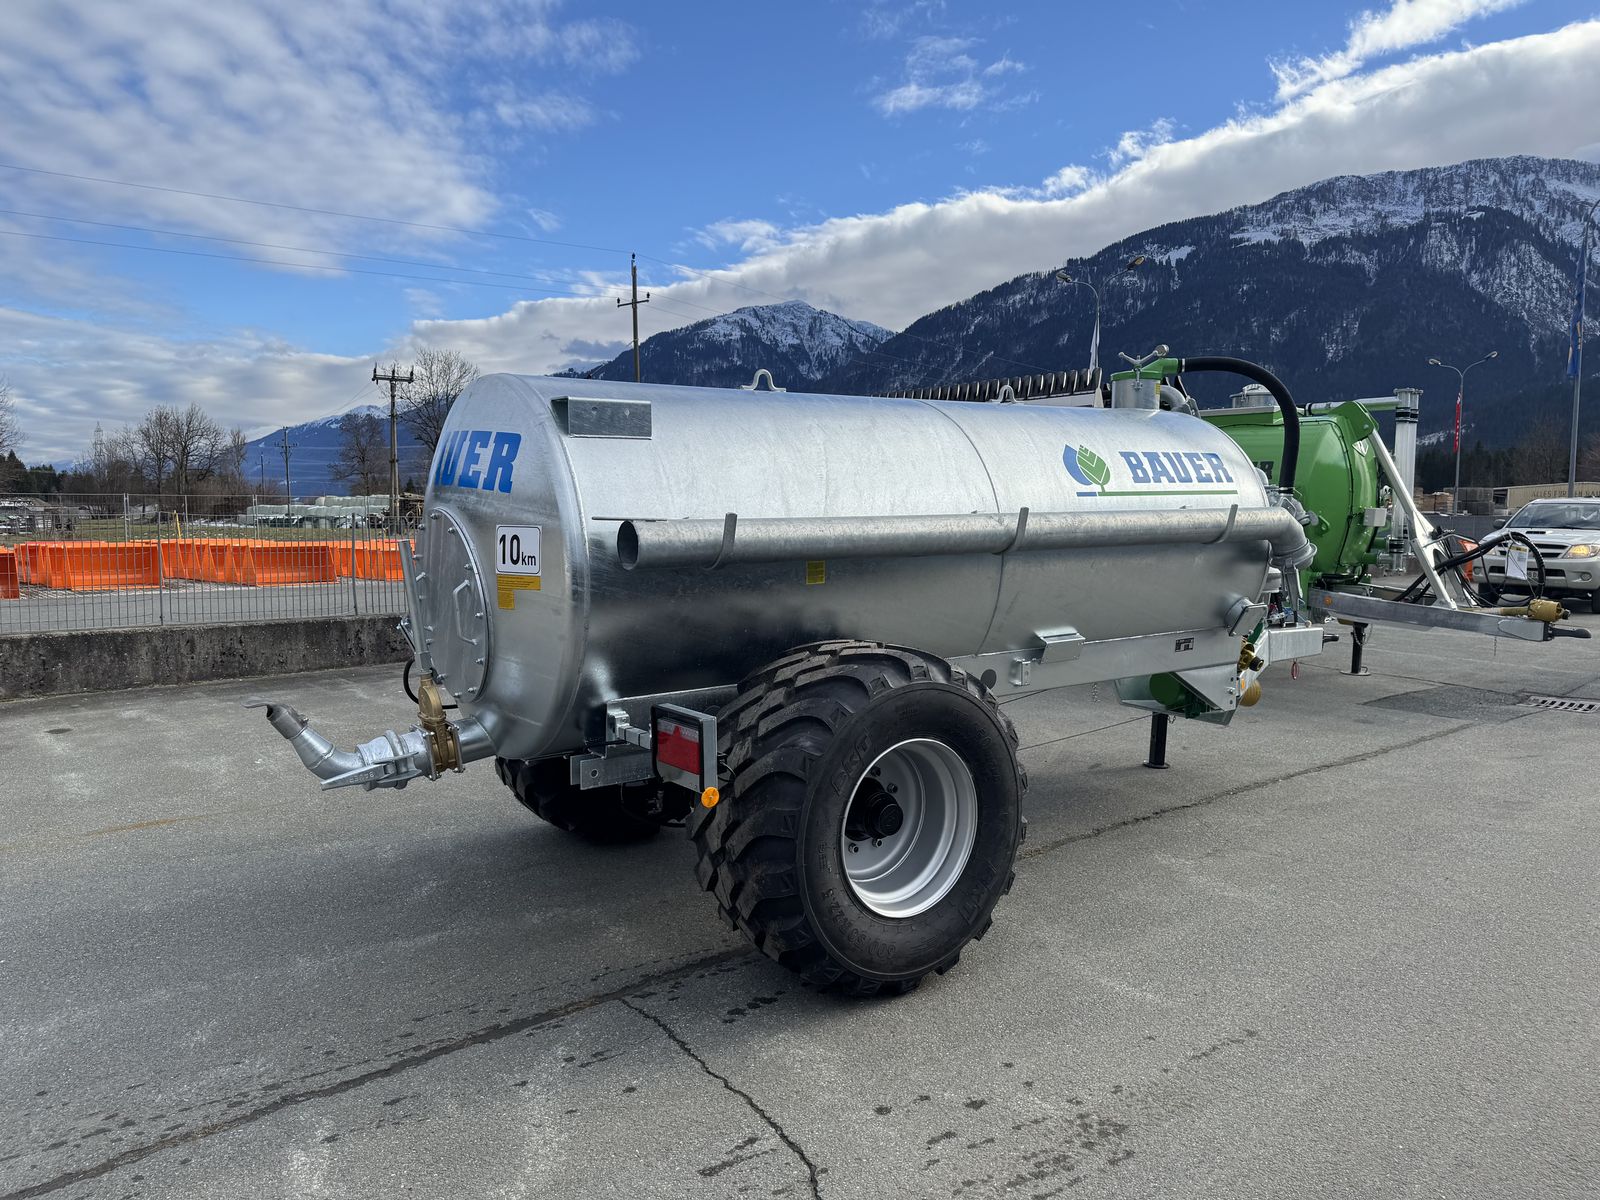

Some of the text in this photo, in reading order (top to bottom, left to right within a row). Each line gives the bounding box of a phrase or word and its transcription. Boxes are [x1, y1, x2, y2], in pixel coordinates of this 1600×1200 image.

[435, 430, 521, 493] UER
[1118, 451, 1234, 484] BAUER
[499, 534, 537, 566] 10 km
